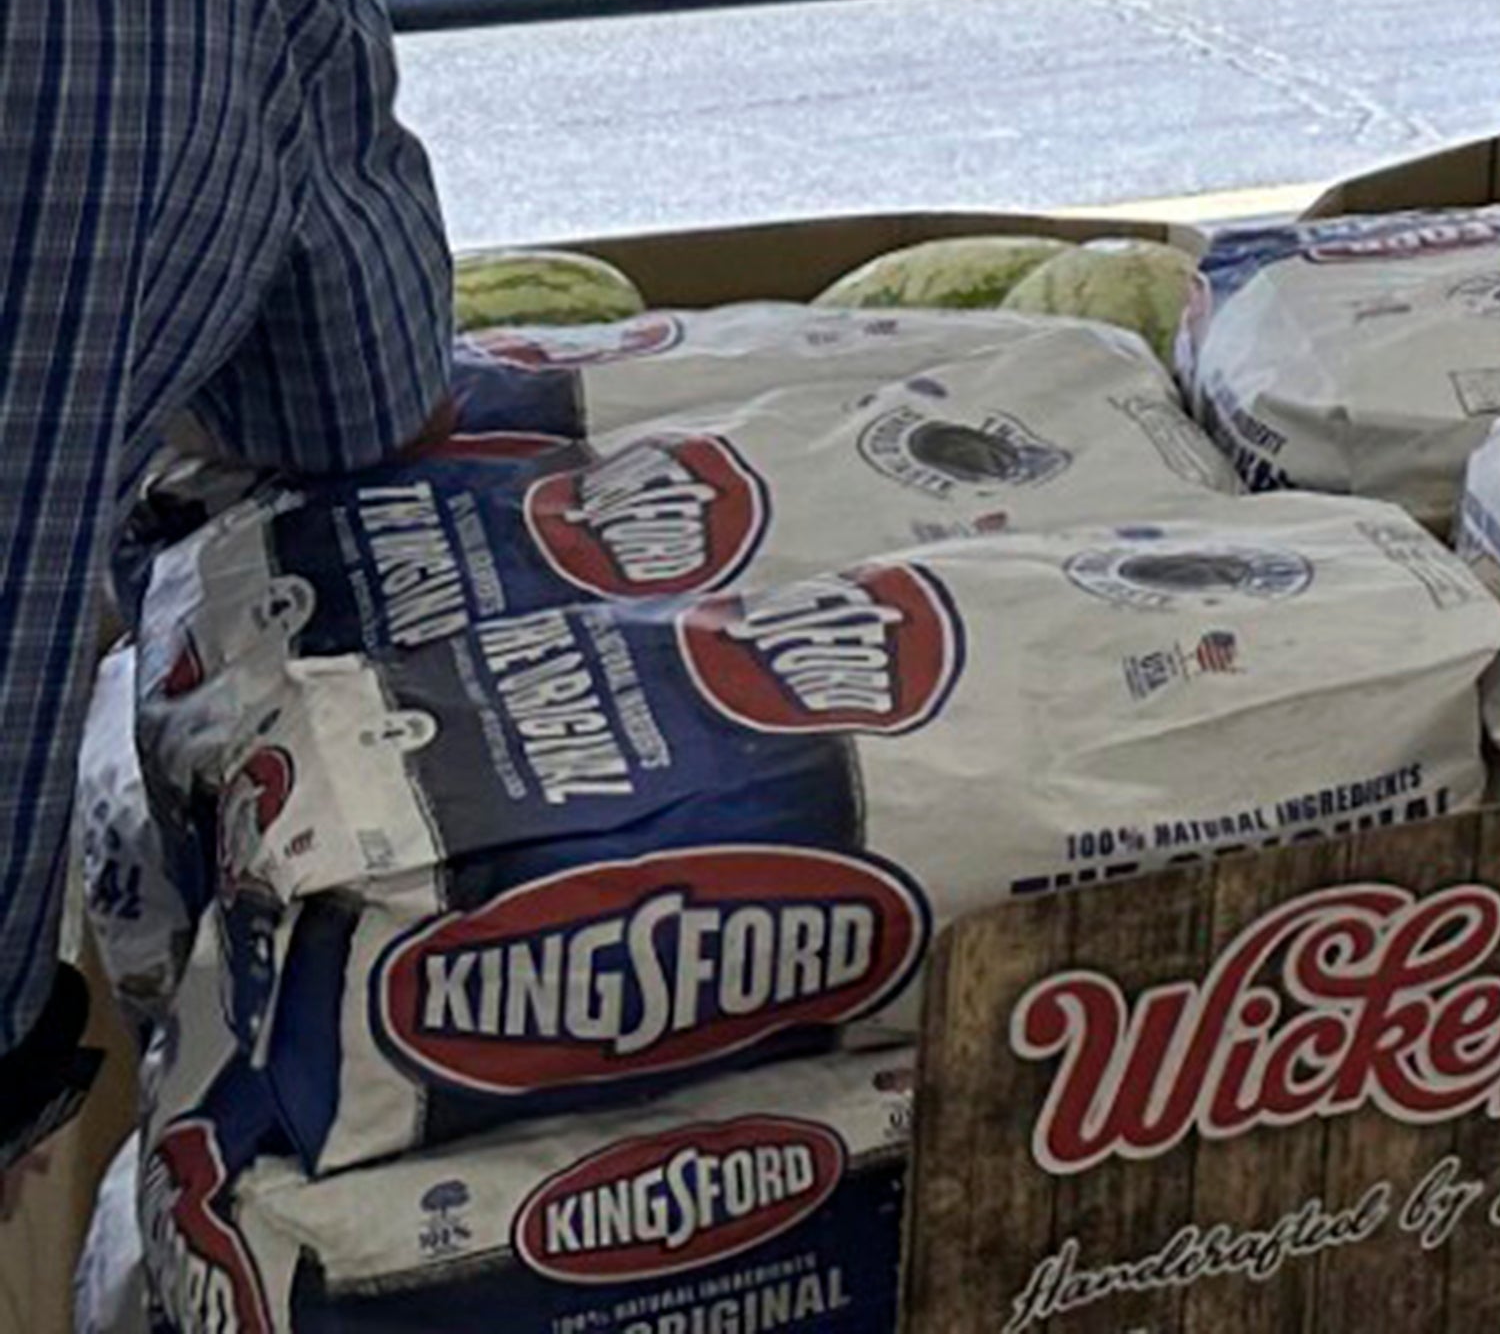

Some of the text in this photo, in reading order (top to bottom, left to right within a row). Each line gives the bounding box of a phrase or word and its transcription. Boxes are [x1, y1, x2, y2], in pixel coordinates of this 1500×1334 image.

[1065, 831, 1144, 862] 100%
[1154, 813, 1269, 849] NATURAL
[1276, 763, 1424, 827] INGREDIENTS
[424, 893, 874, 1055] KINGSFORD
[546, 1147, 813, 1253] KINGSFORD
[1003, 1185, 1392, 1334] Handcrafted
[1399, 1158, 1478, 1247] by
